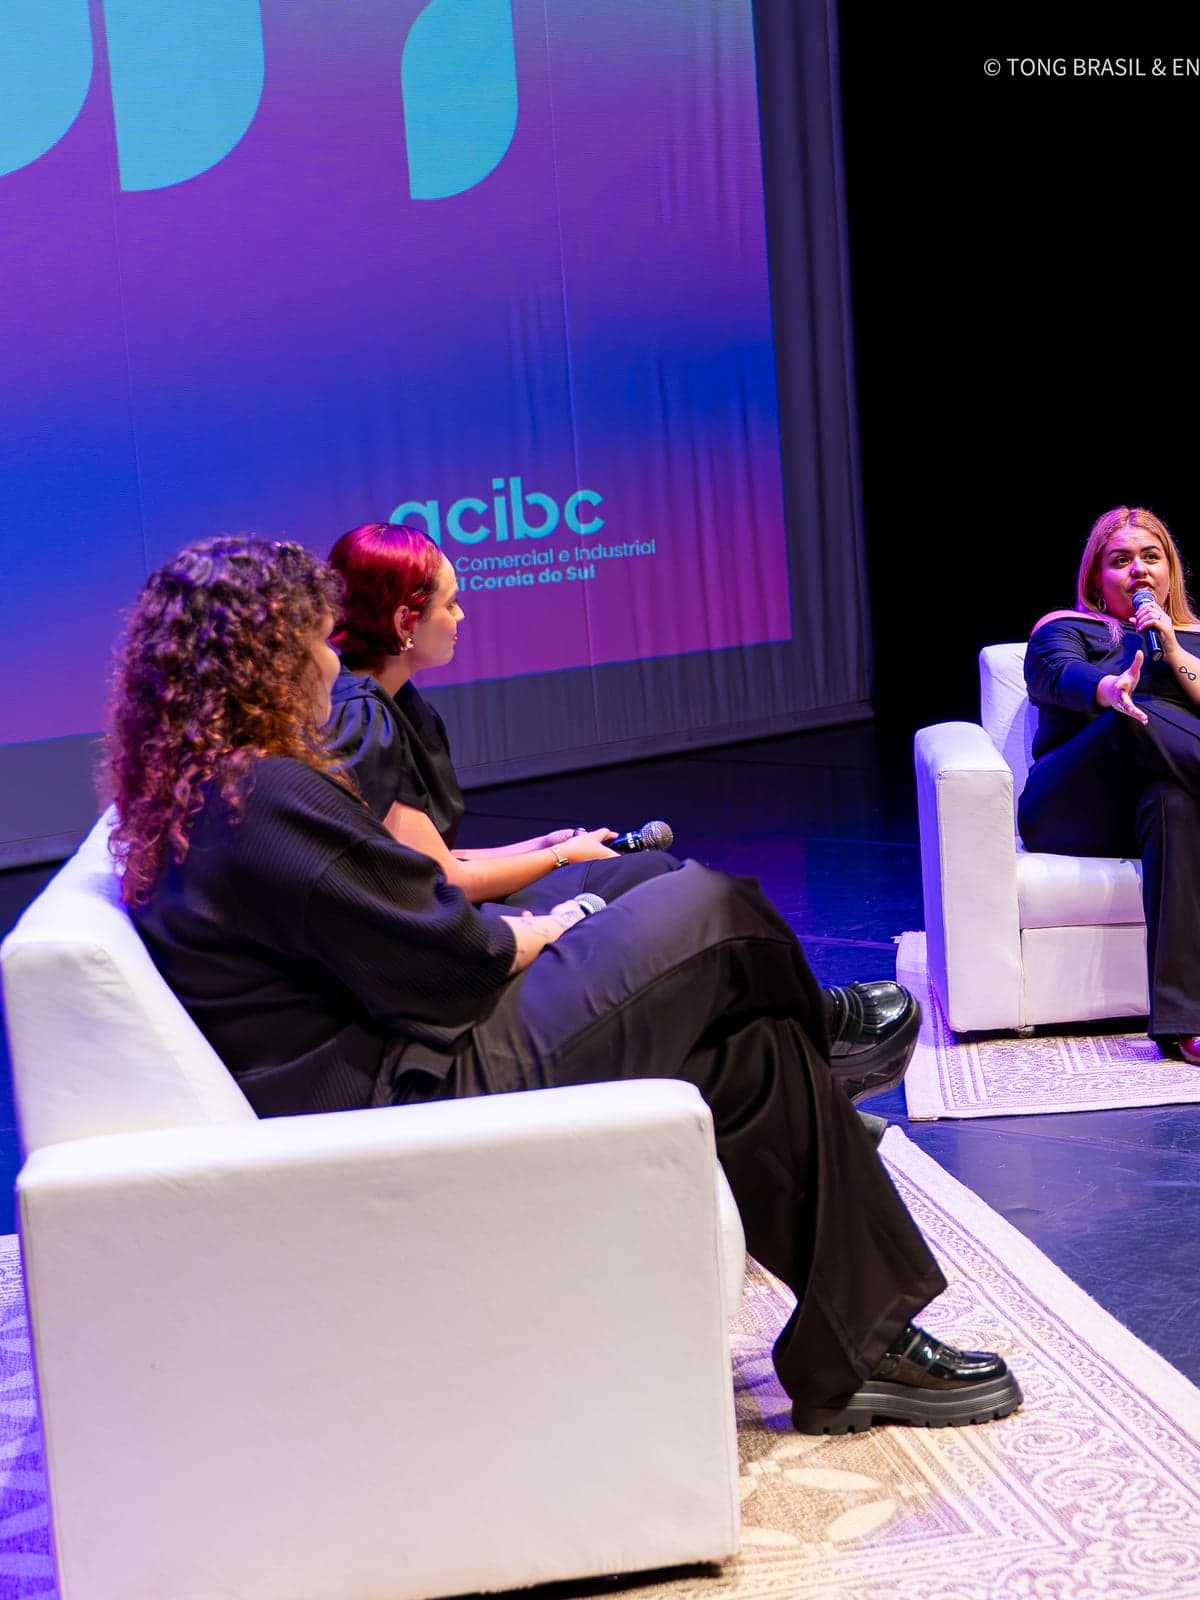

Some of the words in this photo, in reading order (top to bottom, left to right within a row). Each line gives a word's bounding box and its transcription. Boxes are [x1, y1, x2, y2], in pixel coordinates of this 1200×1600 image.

[455, 548, 554, 573] Comercial
[558, 549, 571, 563] e
[575, 539, 656, 562] Industrial
[470, 570, 535, 592] Coreia
[538, 568, 562, 584] do
[566, 564, 596, 581] Sul
